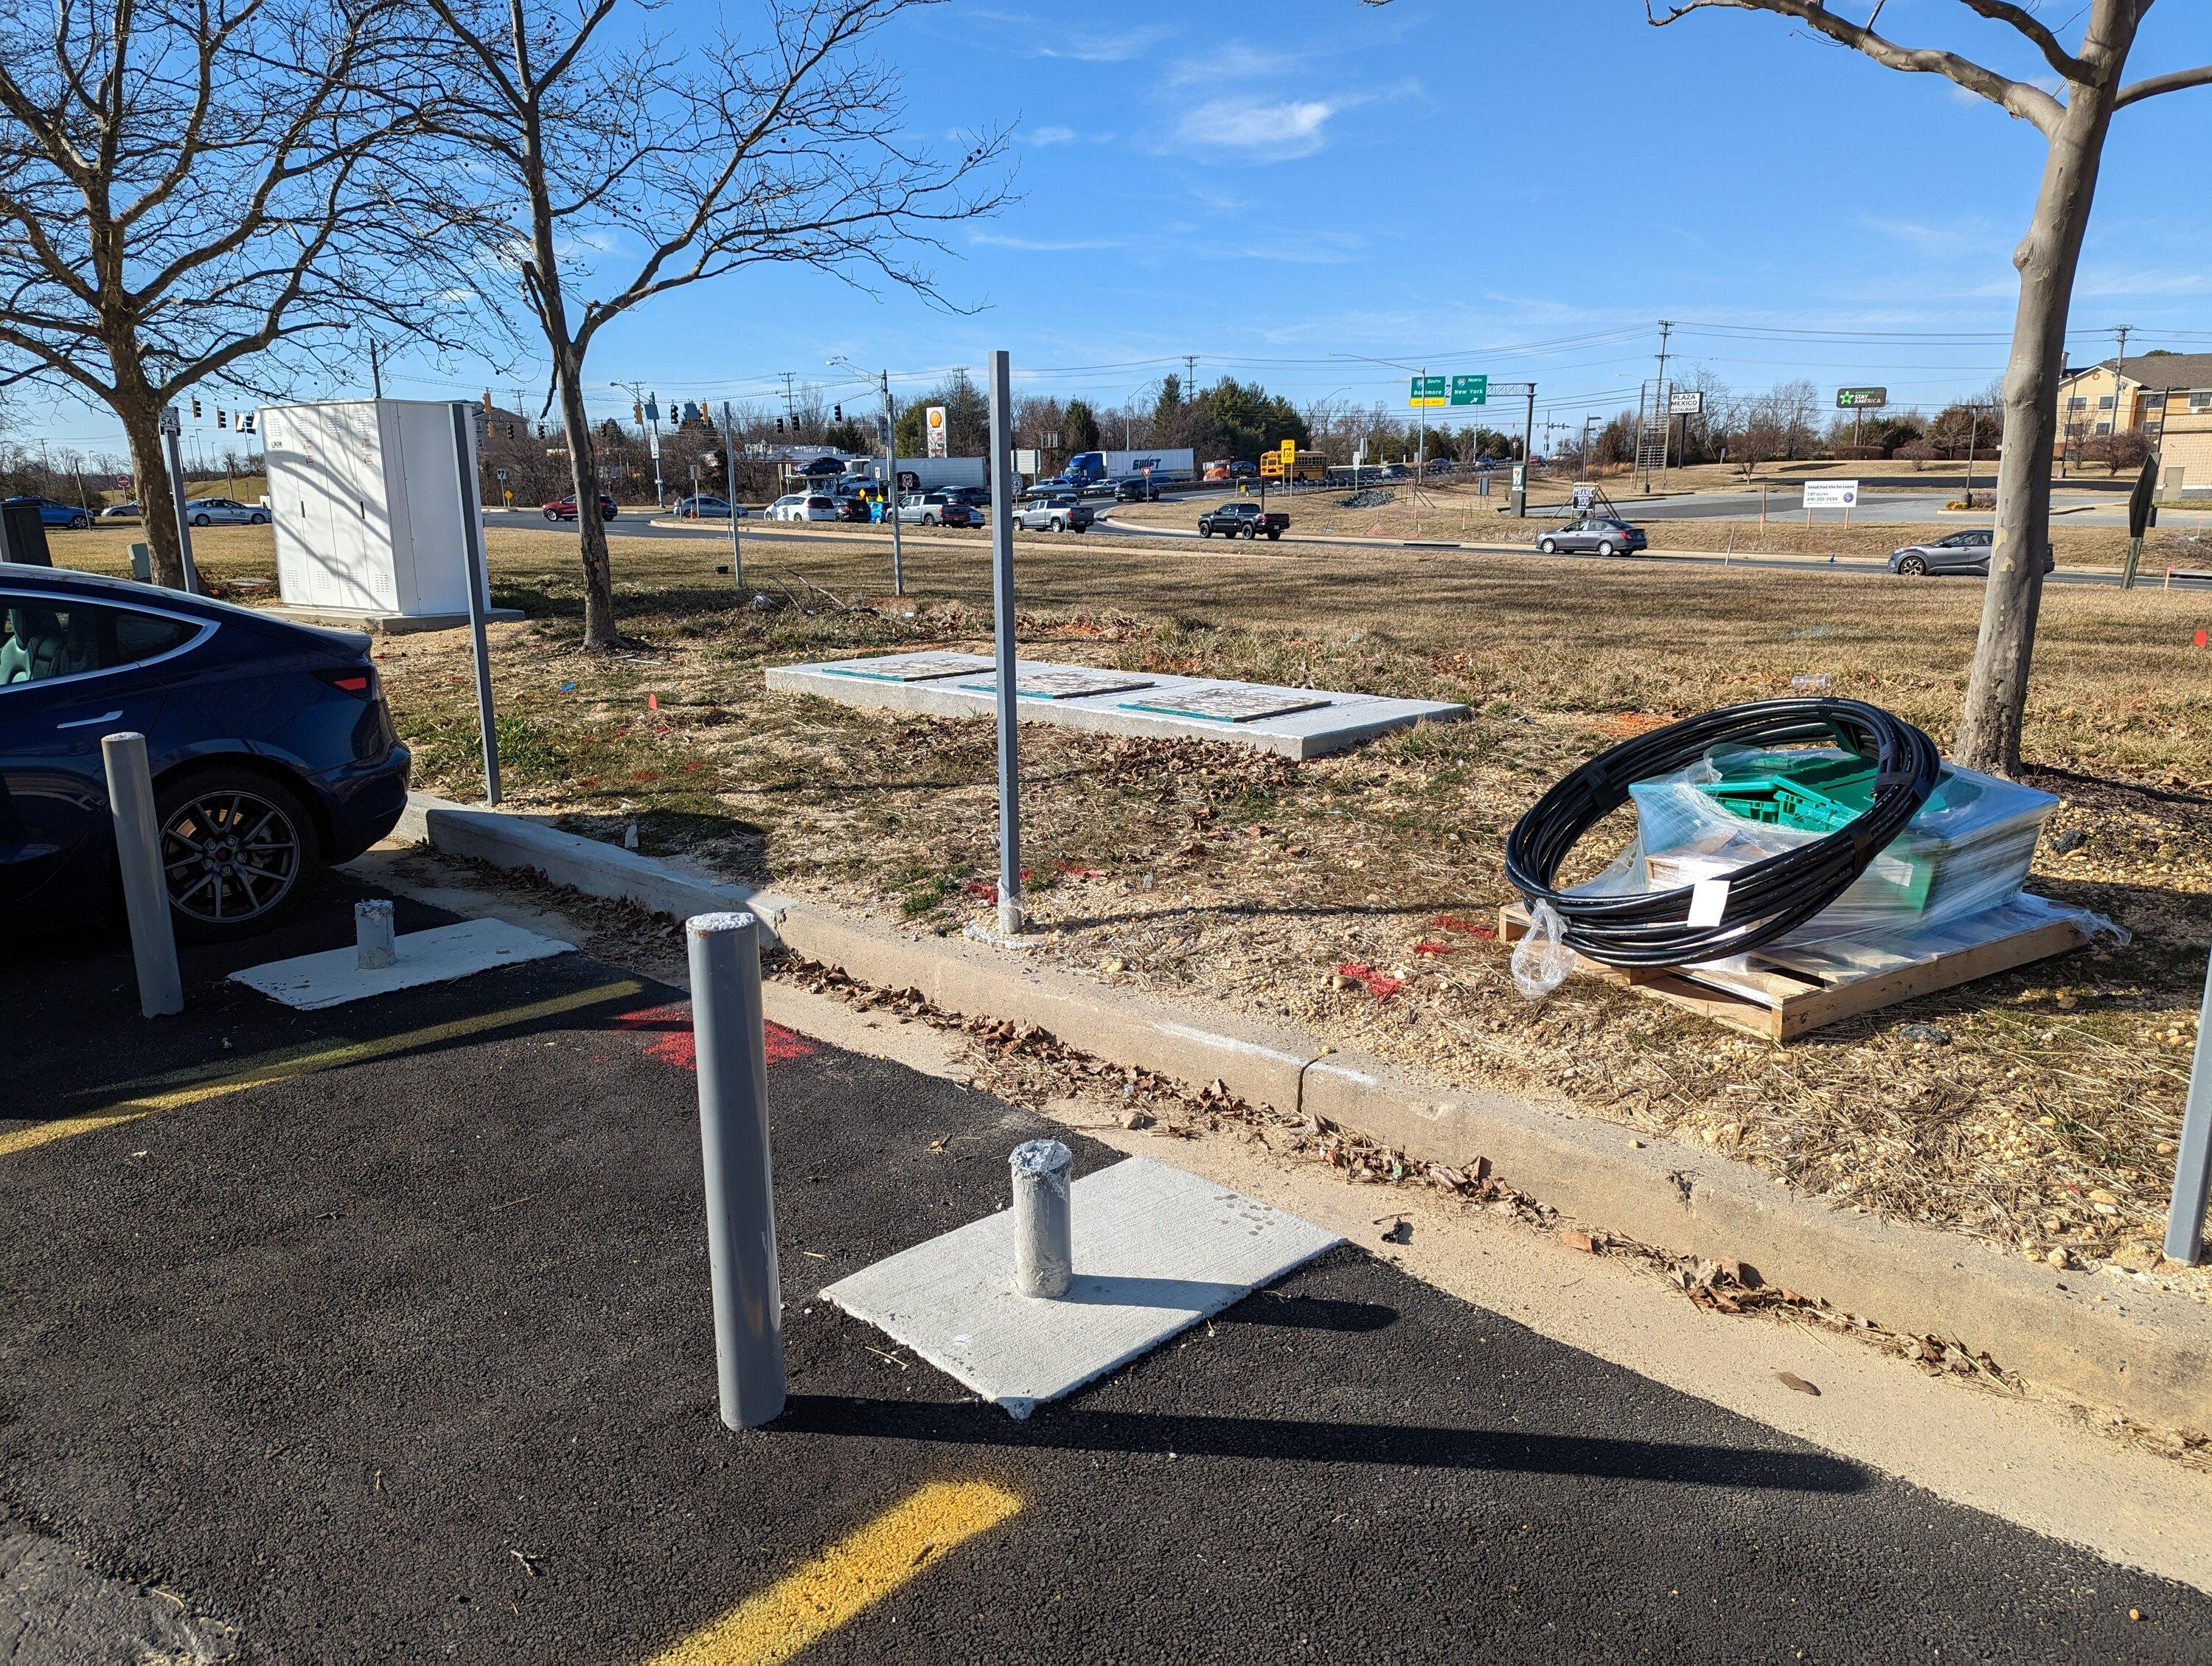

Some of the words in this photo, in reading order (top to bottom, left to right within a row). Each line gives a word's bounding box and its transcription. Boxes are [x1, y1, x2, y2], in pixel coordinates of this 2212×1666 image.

[161, 417, 178, 426] 543
[1133, 454, 1161, 471] SWIFT
[1574, 488, 1594, 496] THANK
[1578, 496, 1589, 505] YOU
